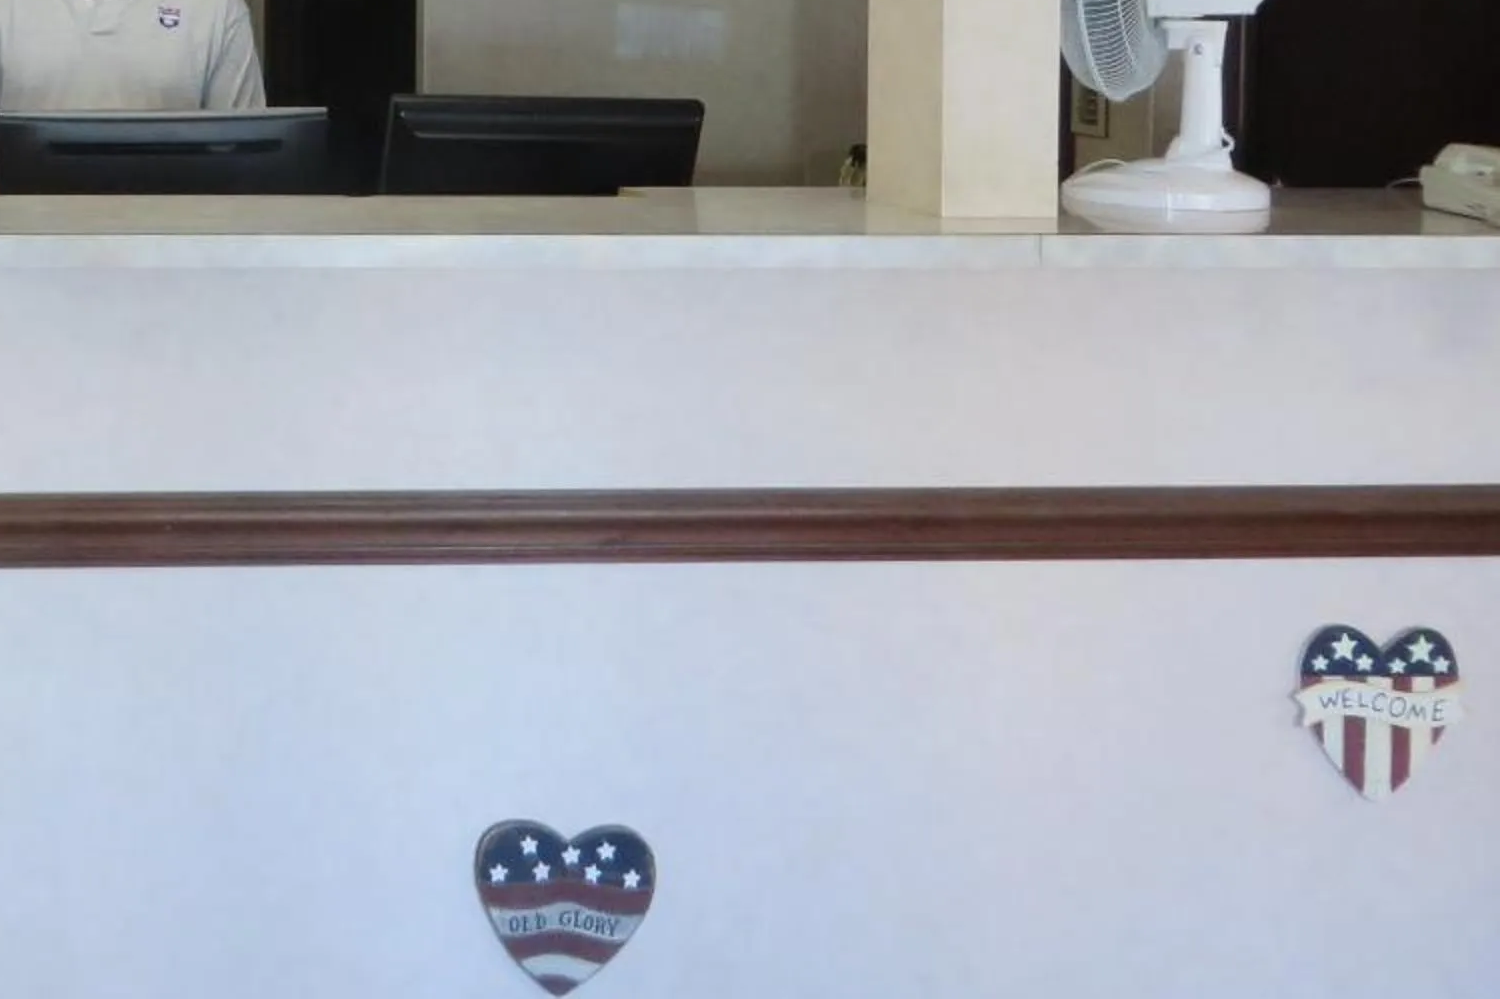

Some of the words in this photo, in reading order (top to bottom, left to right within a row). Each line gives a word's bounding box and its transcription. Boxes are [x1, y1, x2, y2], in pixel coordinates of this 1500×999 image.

[1319, 688, 1447, 722] WELCOME
[508, 913, 548, 933] OLD
[558, 910, 620, 937] GLORY
